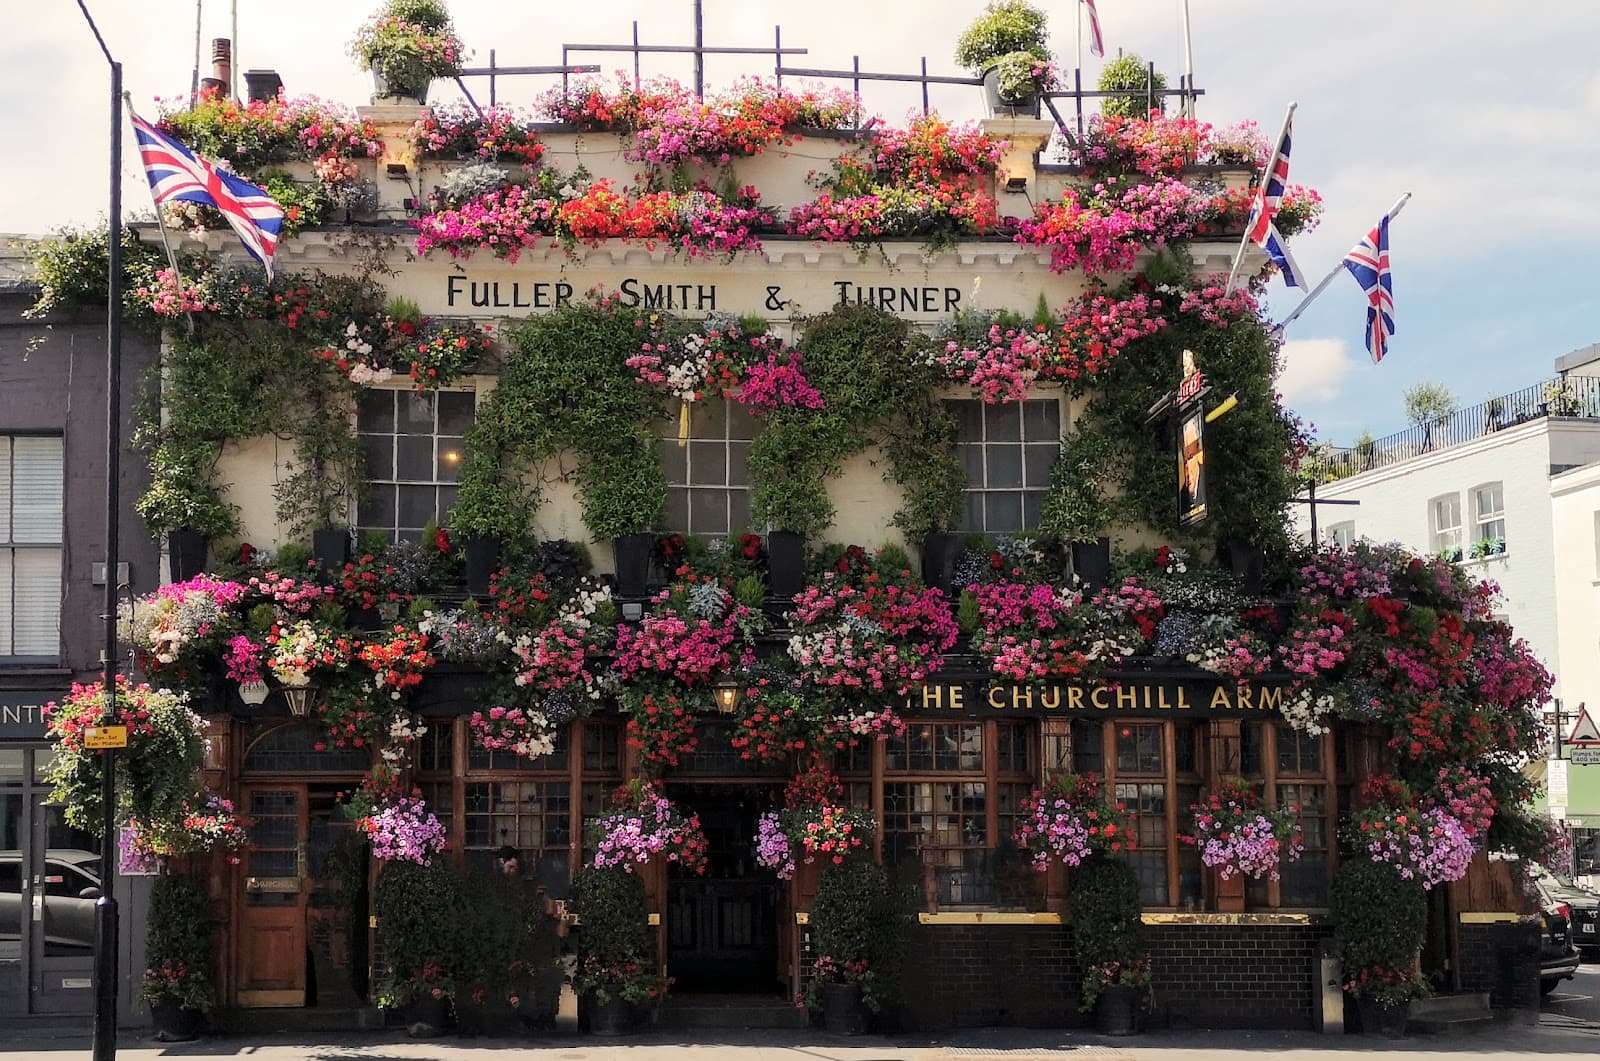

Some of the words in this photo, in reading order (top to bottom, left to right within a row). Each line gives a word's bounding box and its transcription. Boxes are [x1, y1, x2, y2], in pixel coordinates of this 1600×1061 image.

[448, 276, 574, 308] FULLER
[620, 279, 716, 310] SMITH
[765, 286, 788, 311] &
[834, 281, 961, 313] TURNER
[905, 685, 964, 709] HE
[988, 685, 1191, 709] CHURCHILL
